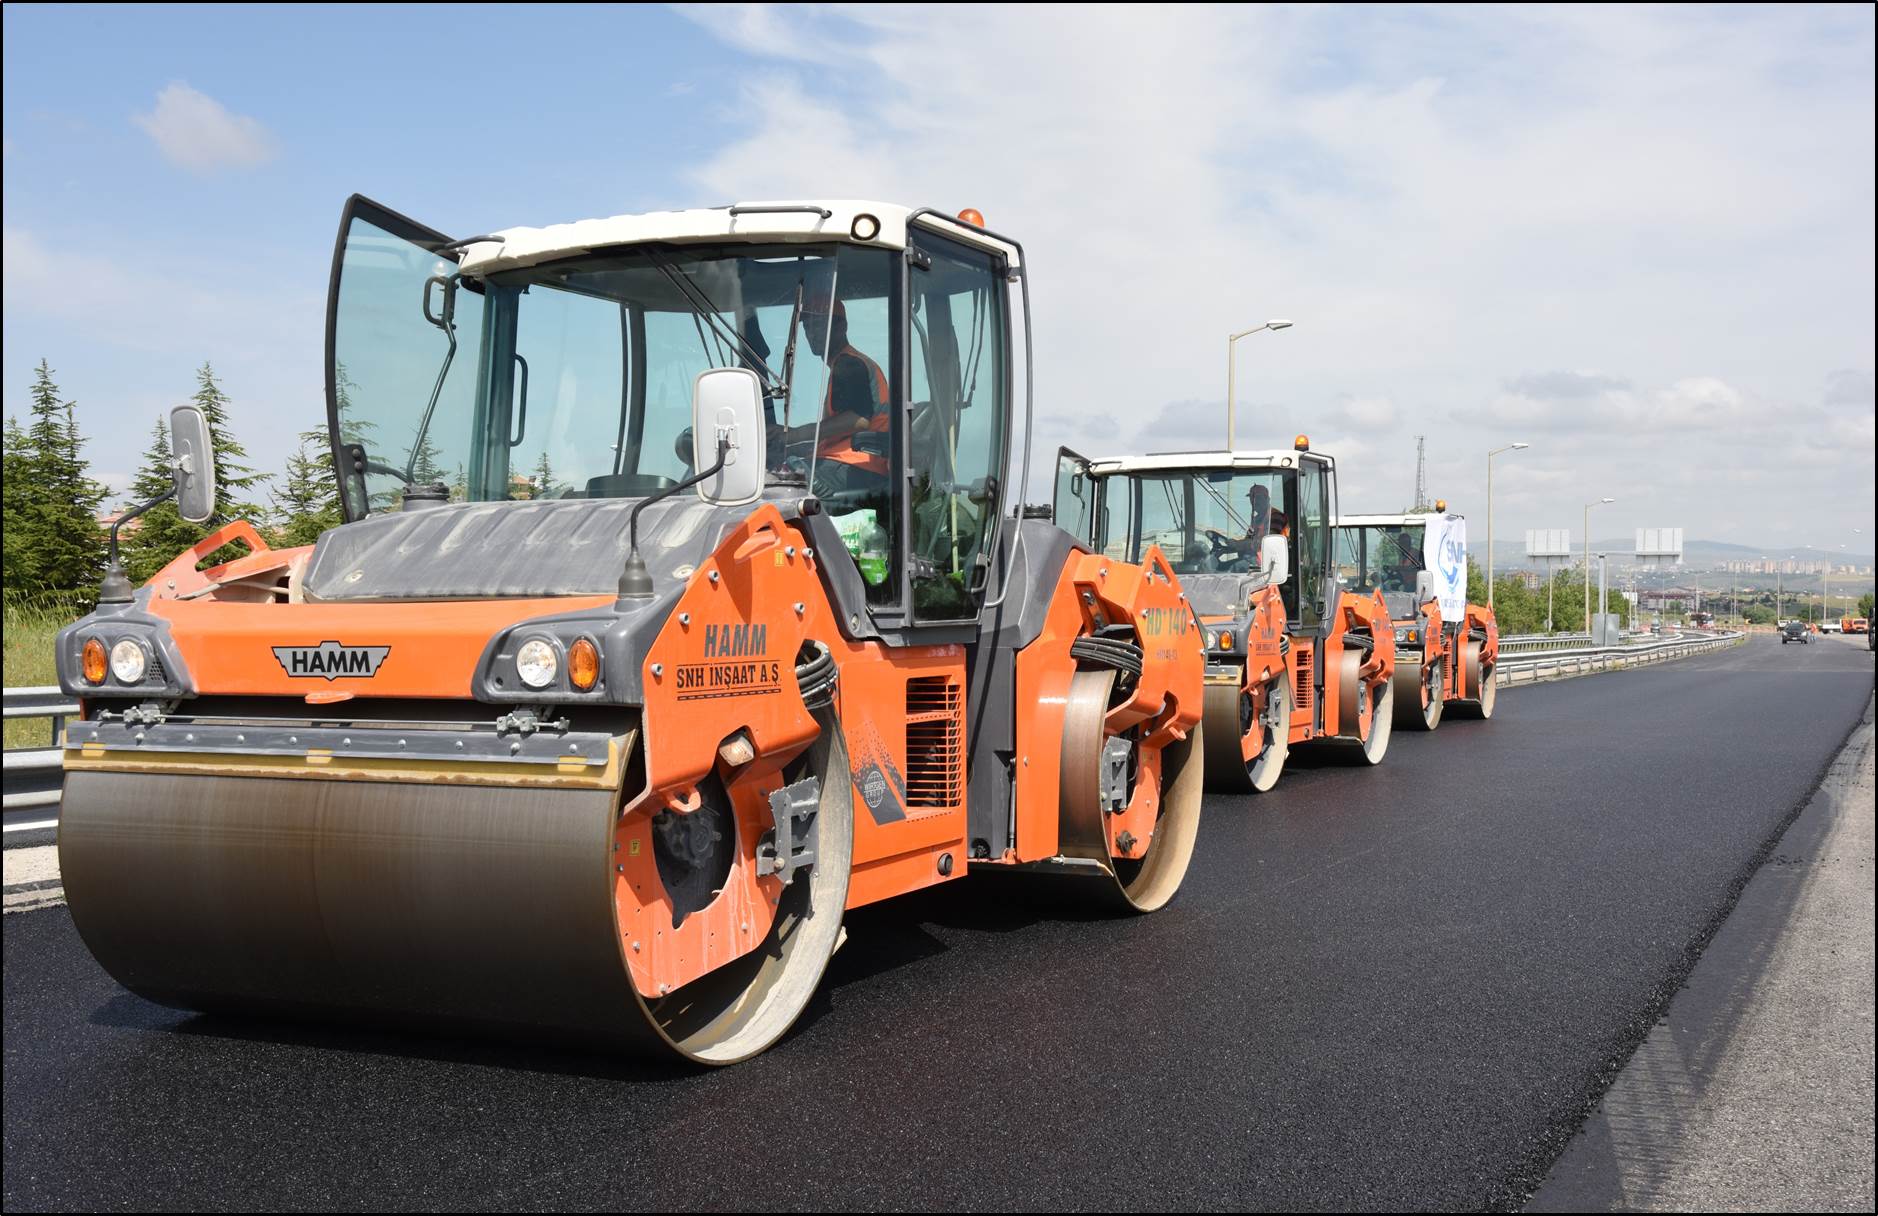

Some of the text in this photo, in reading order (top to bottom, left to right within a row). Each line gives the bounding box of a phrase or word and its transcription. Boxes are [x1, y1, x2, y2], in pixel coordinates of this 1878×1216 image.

[1169, 607, 1187, 636] 140
[704, 623, 767, 657] HAMM
[292, 650, 371, 673] HAMM
[677, 667, 705, 689] SNH
[710, 662, 756, 690] İNŞAAT
